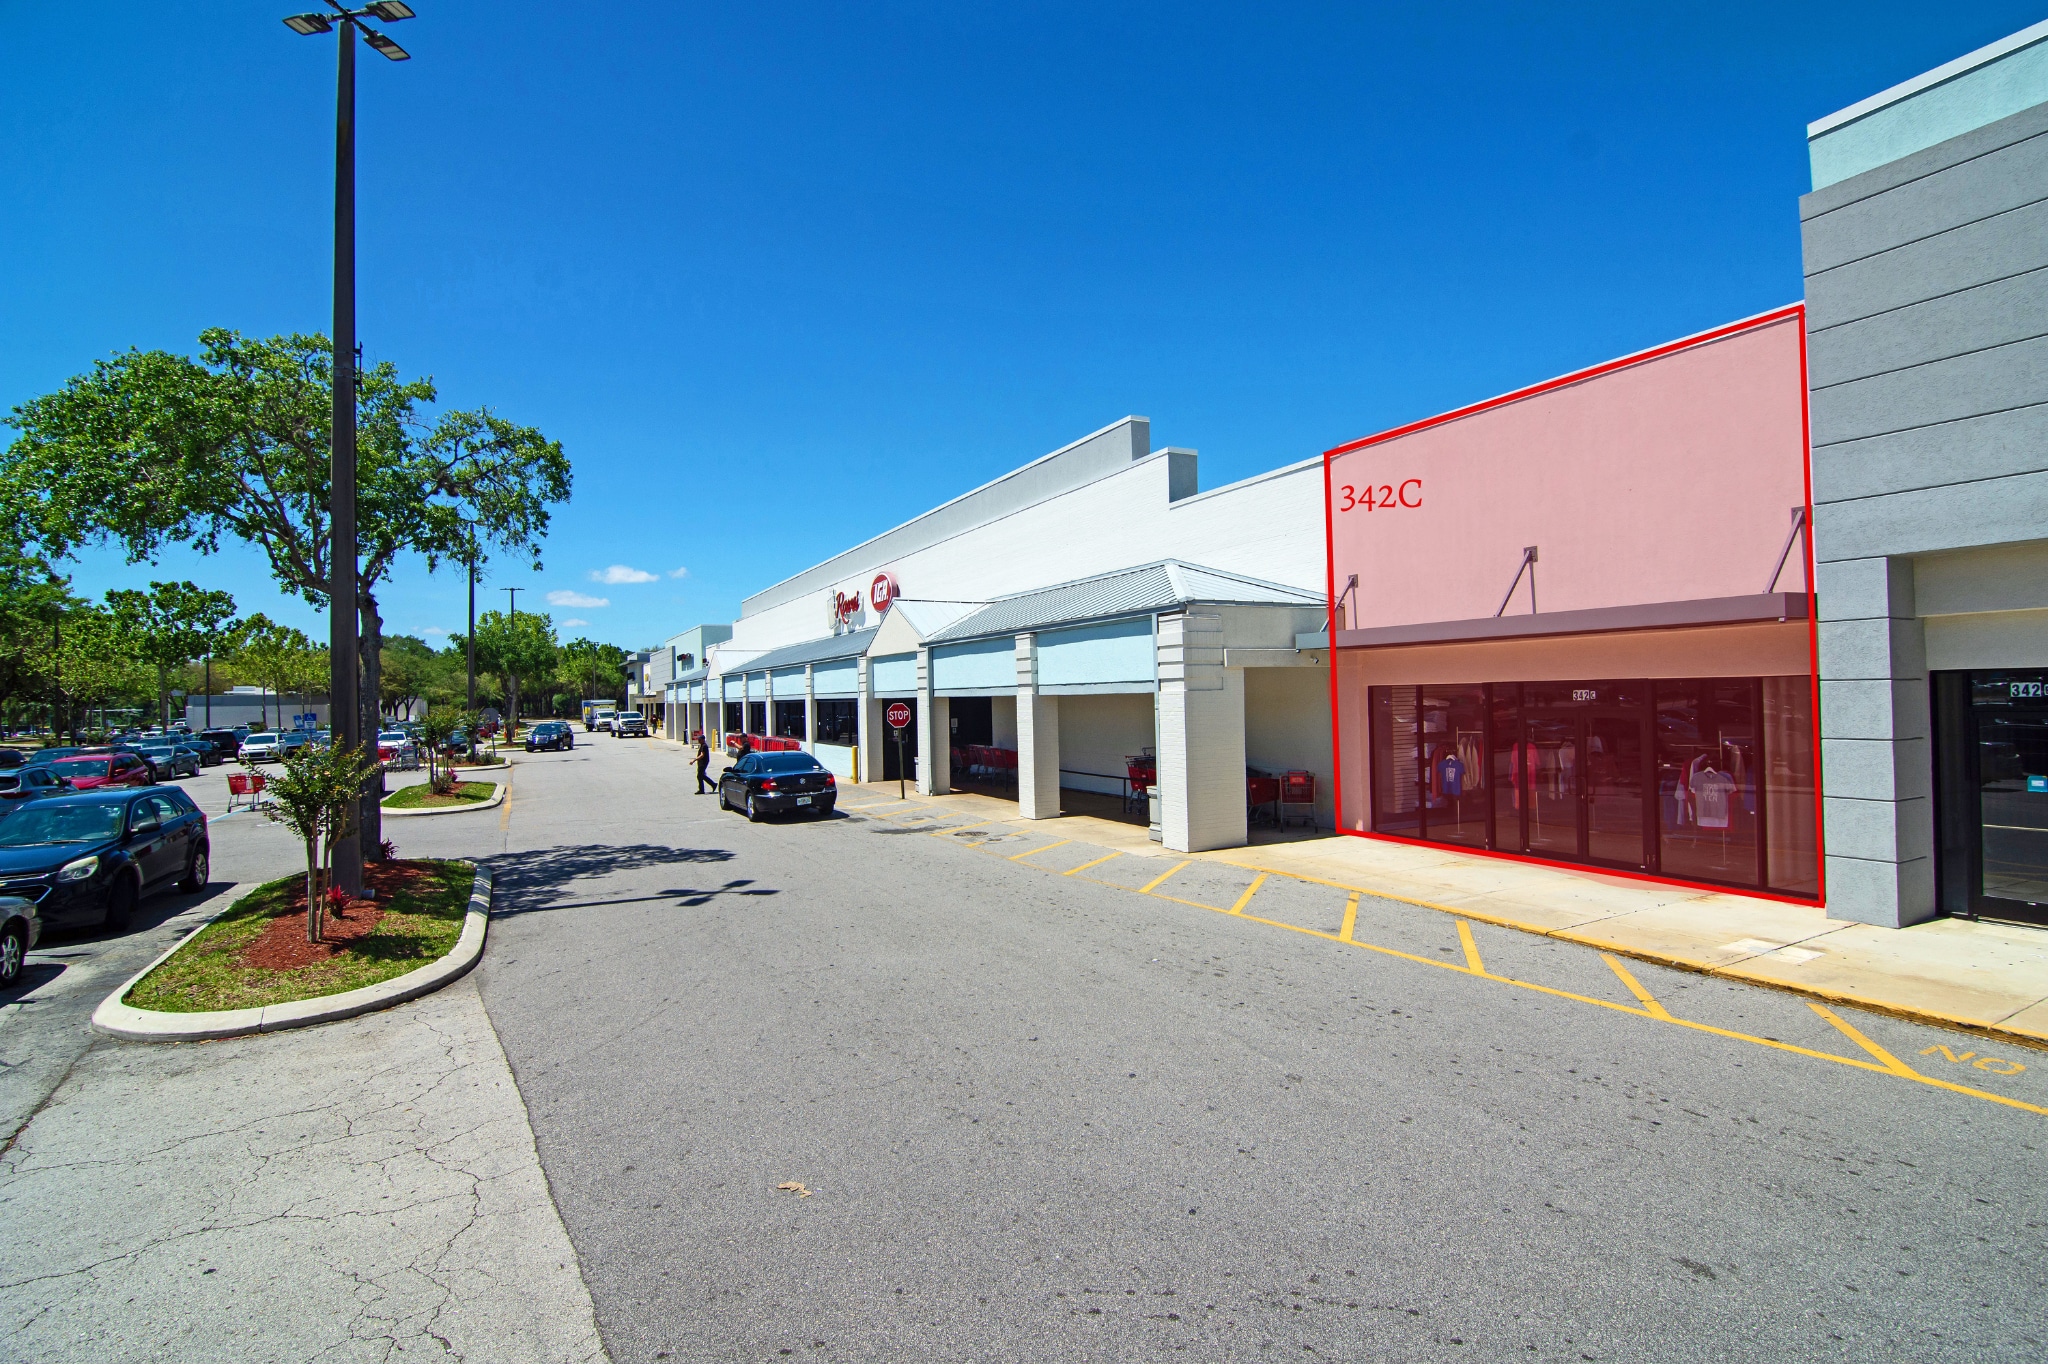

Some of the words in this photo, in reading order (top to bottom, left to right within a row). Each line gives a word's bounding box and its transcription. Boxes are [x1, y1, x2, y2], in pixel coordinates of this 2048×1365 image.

[873, 580, 888, 604] IGA
[889, 711, 909, 720] STOP
[1918, 1044, 2027, 1075] NO
